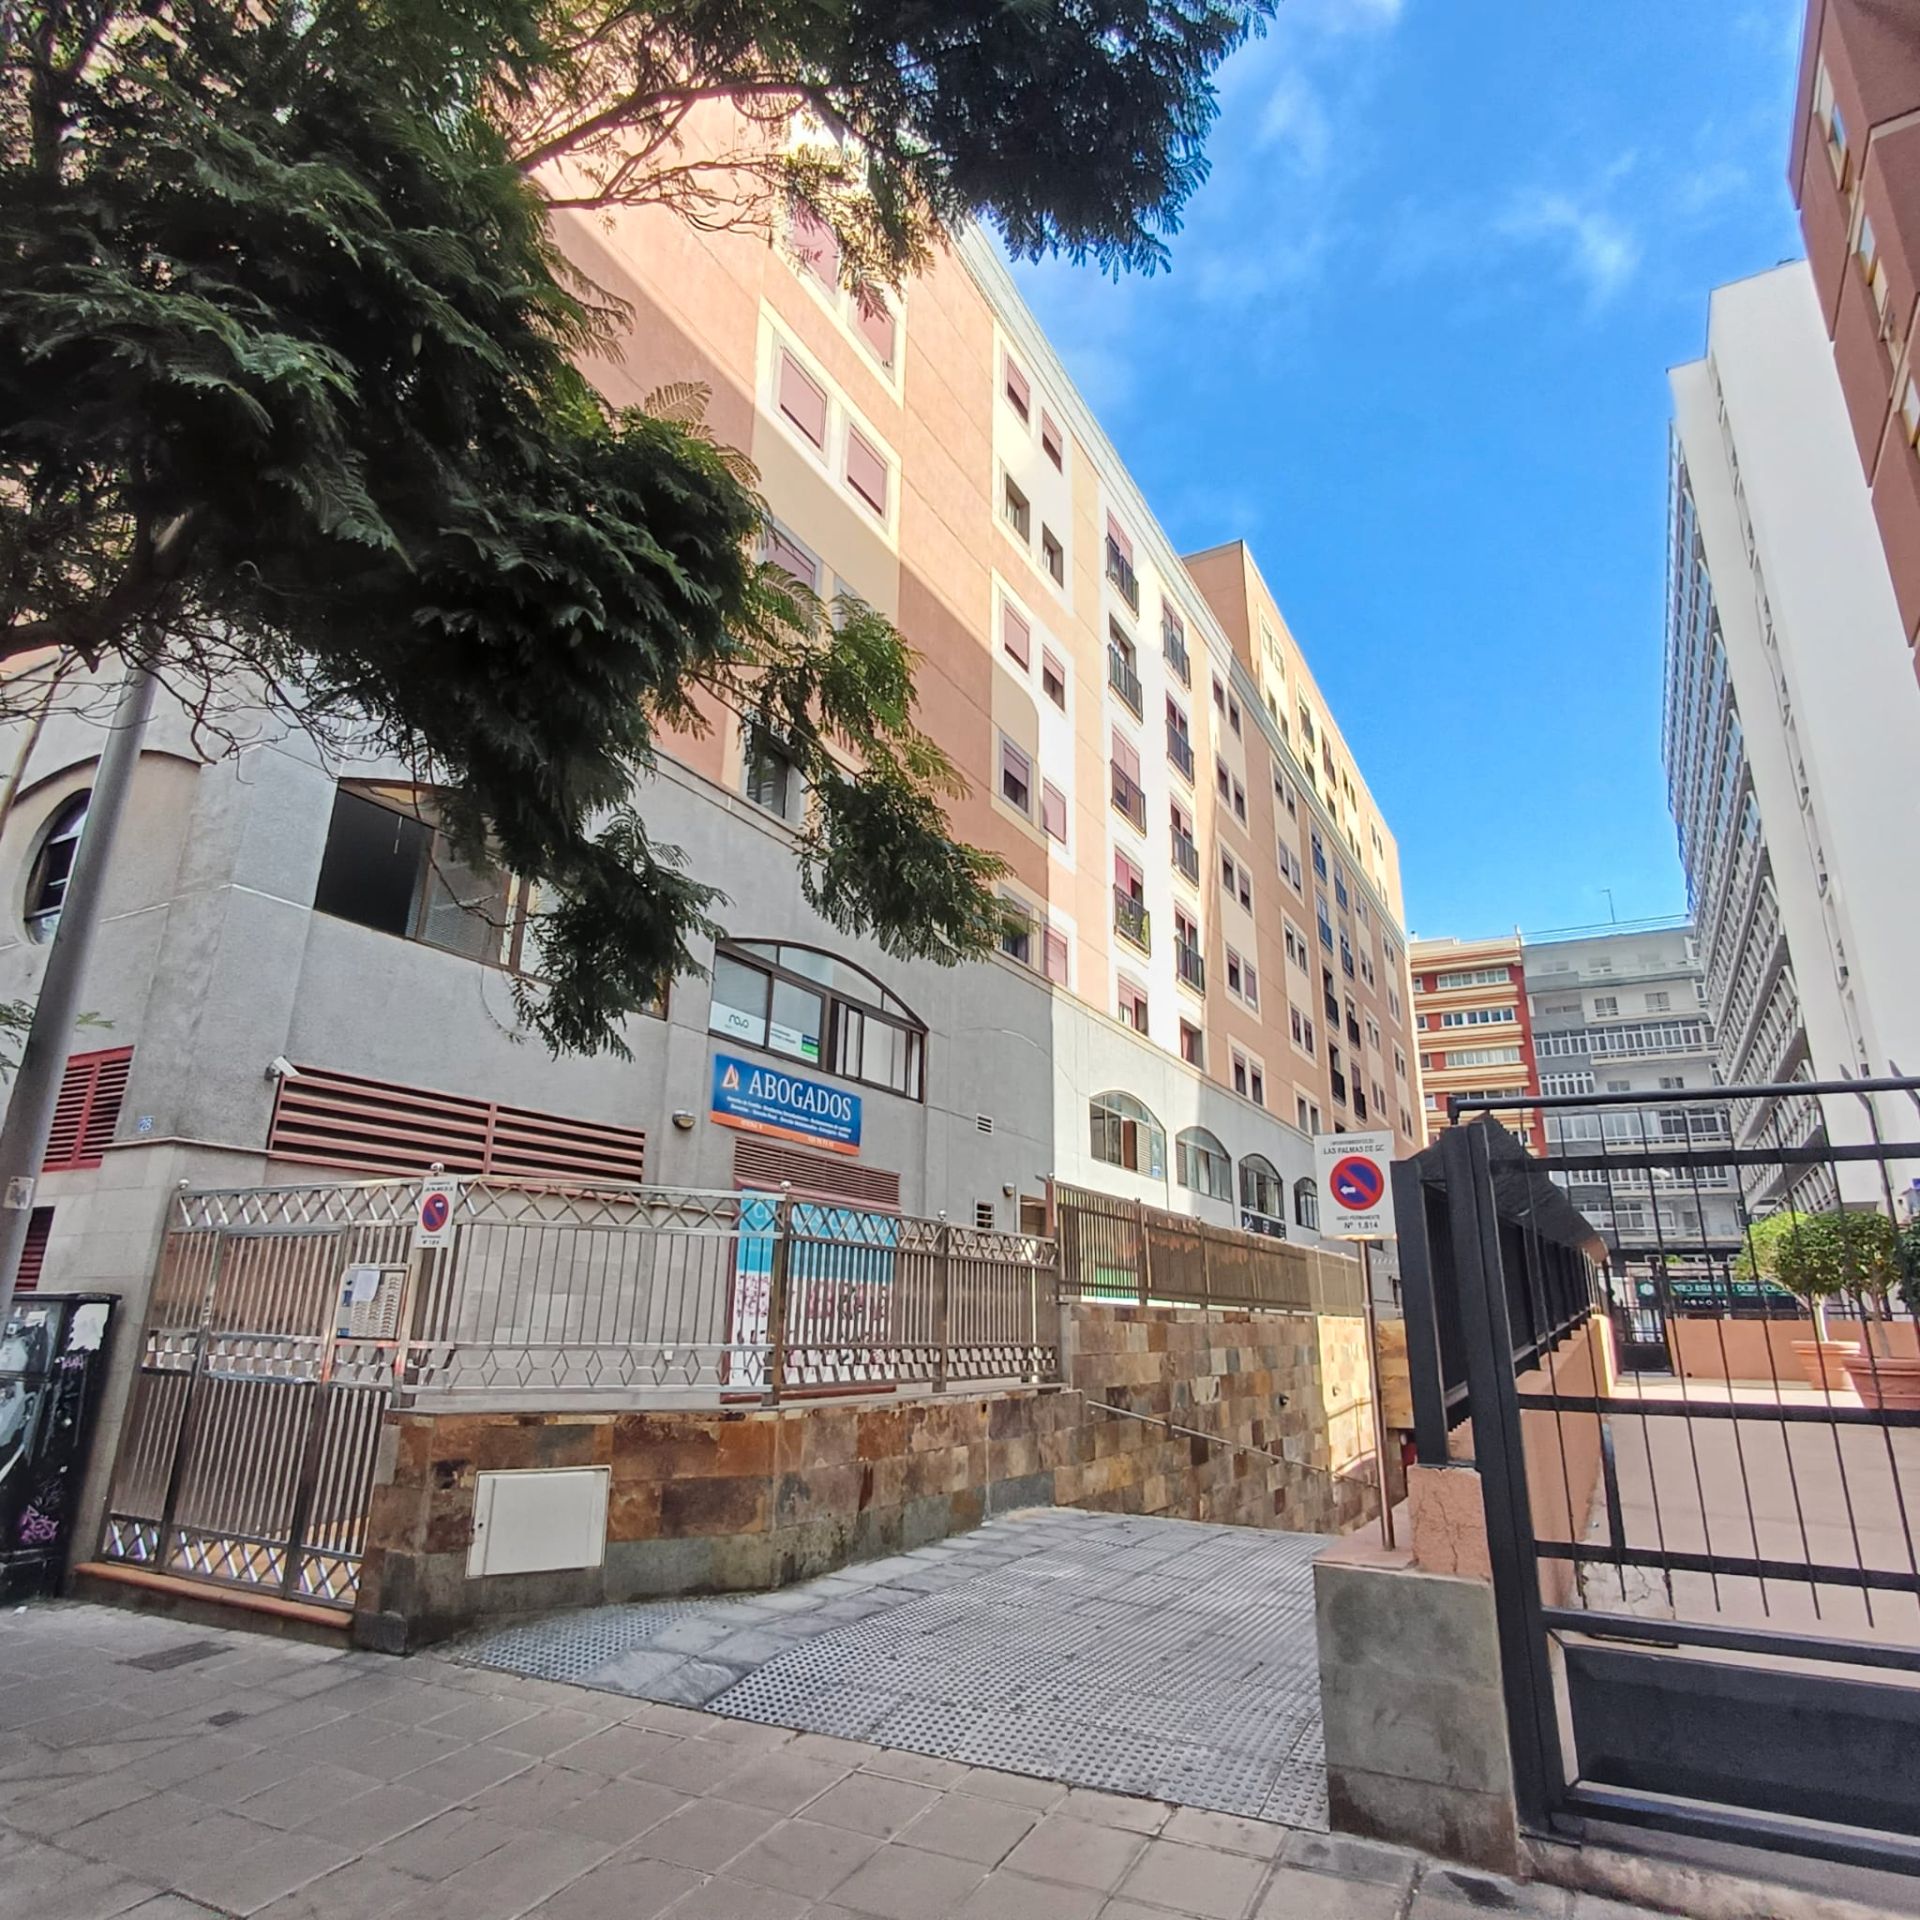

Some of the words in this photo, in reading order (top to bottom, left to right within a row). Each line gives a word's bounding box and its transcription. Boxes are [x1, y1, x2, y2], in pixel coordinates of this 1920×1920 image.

[748, 1070, 852, 1121] ABOGADOS
[1323, 1146, 1337, 1155] LAS
[1337, 1145, 1363, 1154] PALMAS
[1364, 1144, 1374, 1153] DE
